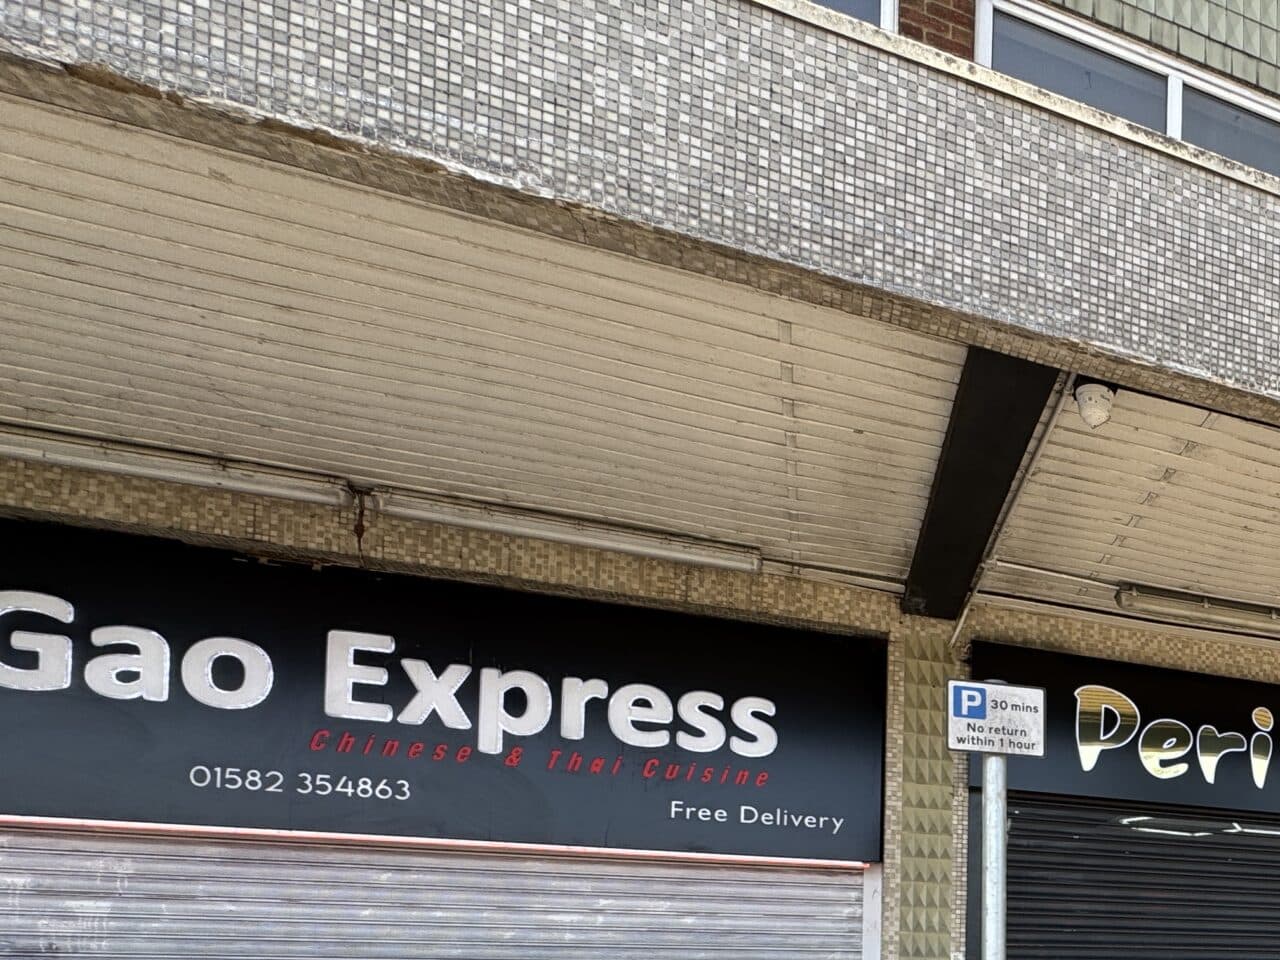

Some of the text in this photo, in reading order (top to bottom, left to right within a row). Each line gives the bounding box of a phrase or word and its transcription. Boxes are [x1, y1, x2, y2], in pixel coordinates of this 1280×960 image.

[0, 590, 778, 757] Gao Express
[961, 689, 982, 715] P
[991, 699, 1039, 713] 30 mins
[956, 735, 1036, 750] within 1 hour
[966, 722, 1027, 737] No return
[1074, 685, 1274, 789] Peri
[309, 728, 770, 788] Chinese & Thai Cuisine
[189, 765, 411, 800] 01582 354863
[670, 800, 844, 834] Free Delivery
